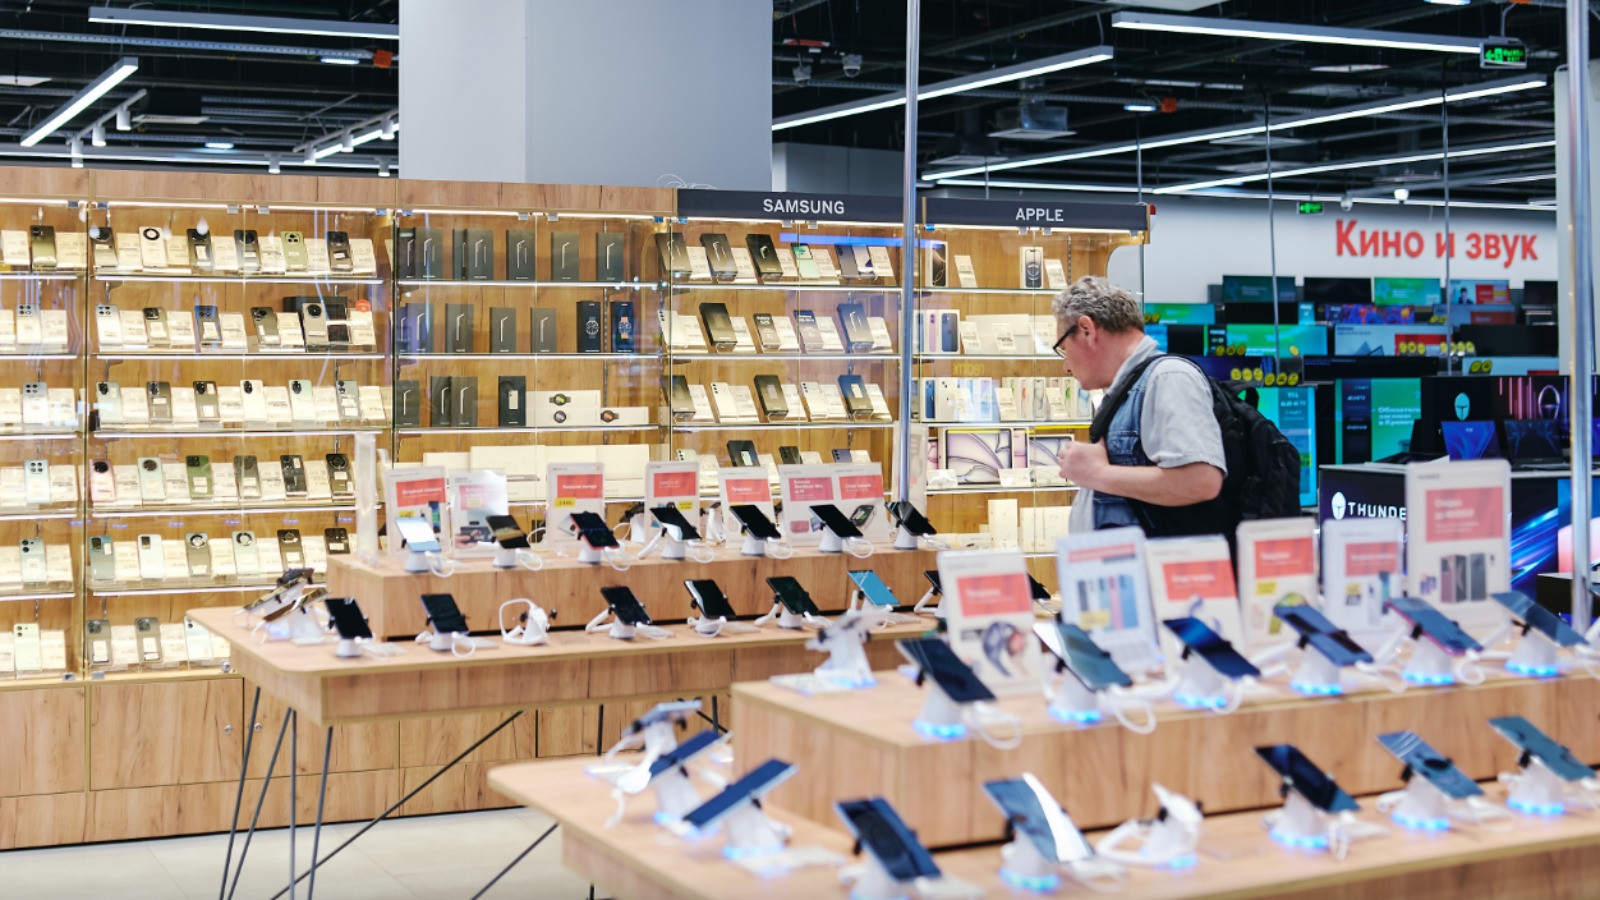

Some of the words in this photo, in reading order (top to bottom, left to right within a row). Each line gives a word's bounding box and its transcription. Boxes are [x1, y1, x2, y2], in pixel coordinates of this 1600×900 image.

[763, 198, 845, 215] SAMSUNG
[1015, 207, 1064, 222] APPLE
[1336, 219, 1425, 258] Кино
[1435, 231, 1455, 259] и
[1465, 232, 1539, 269] звук
